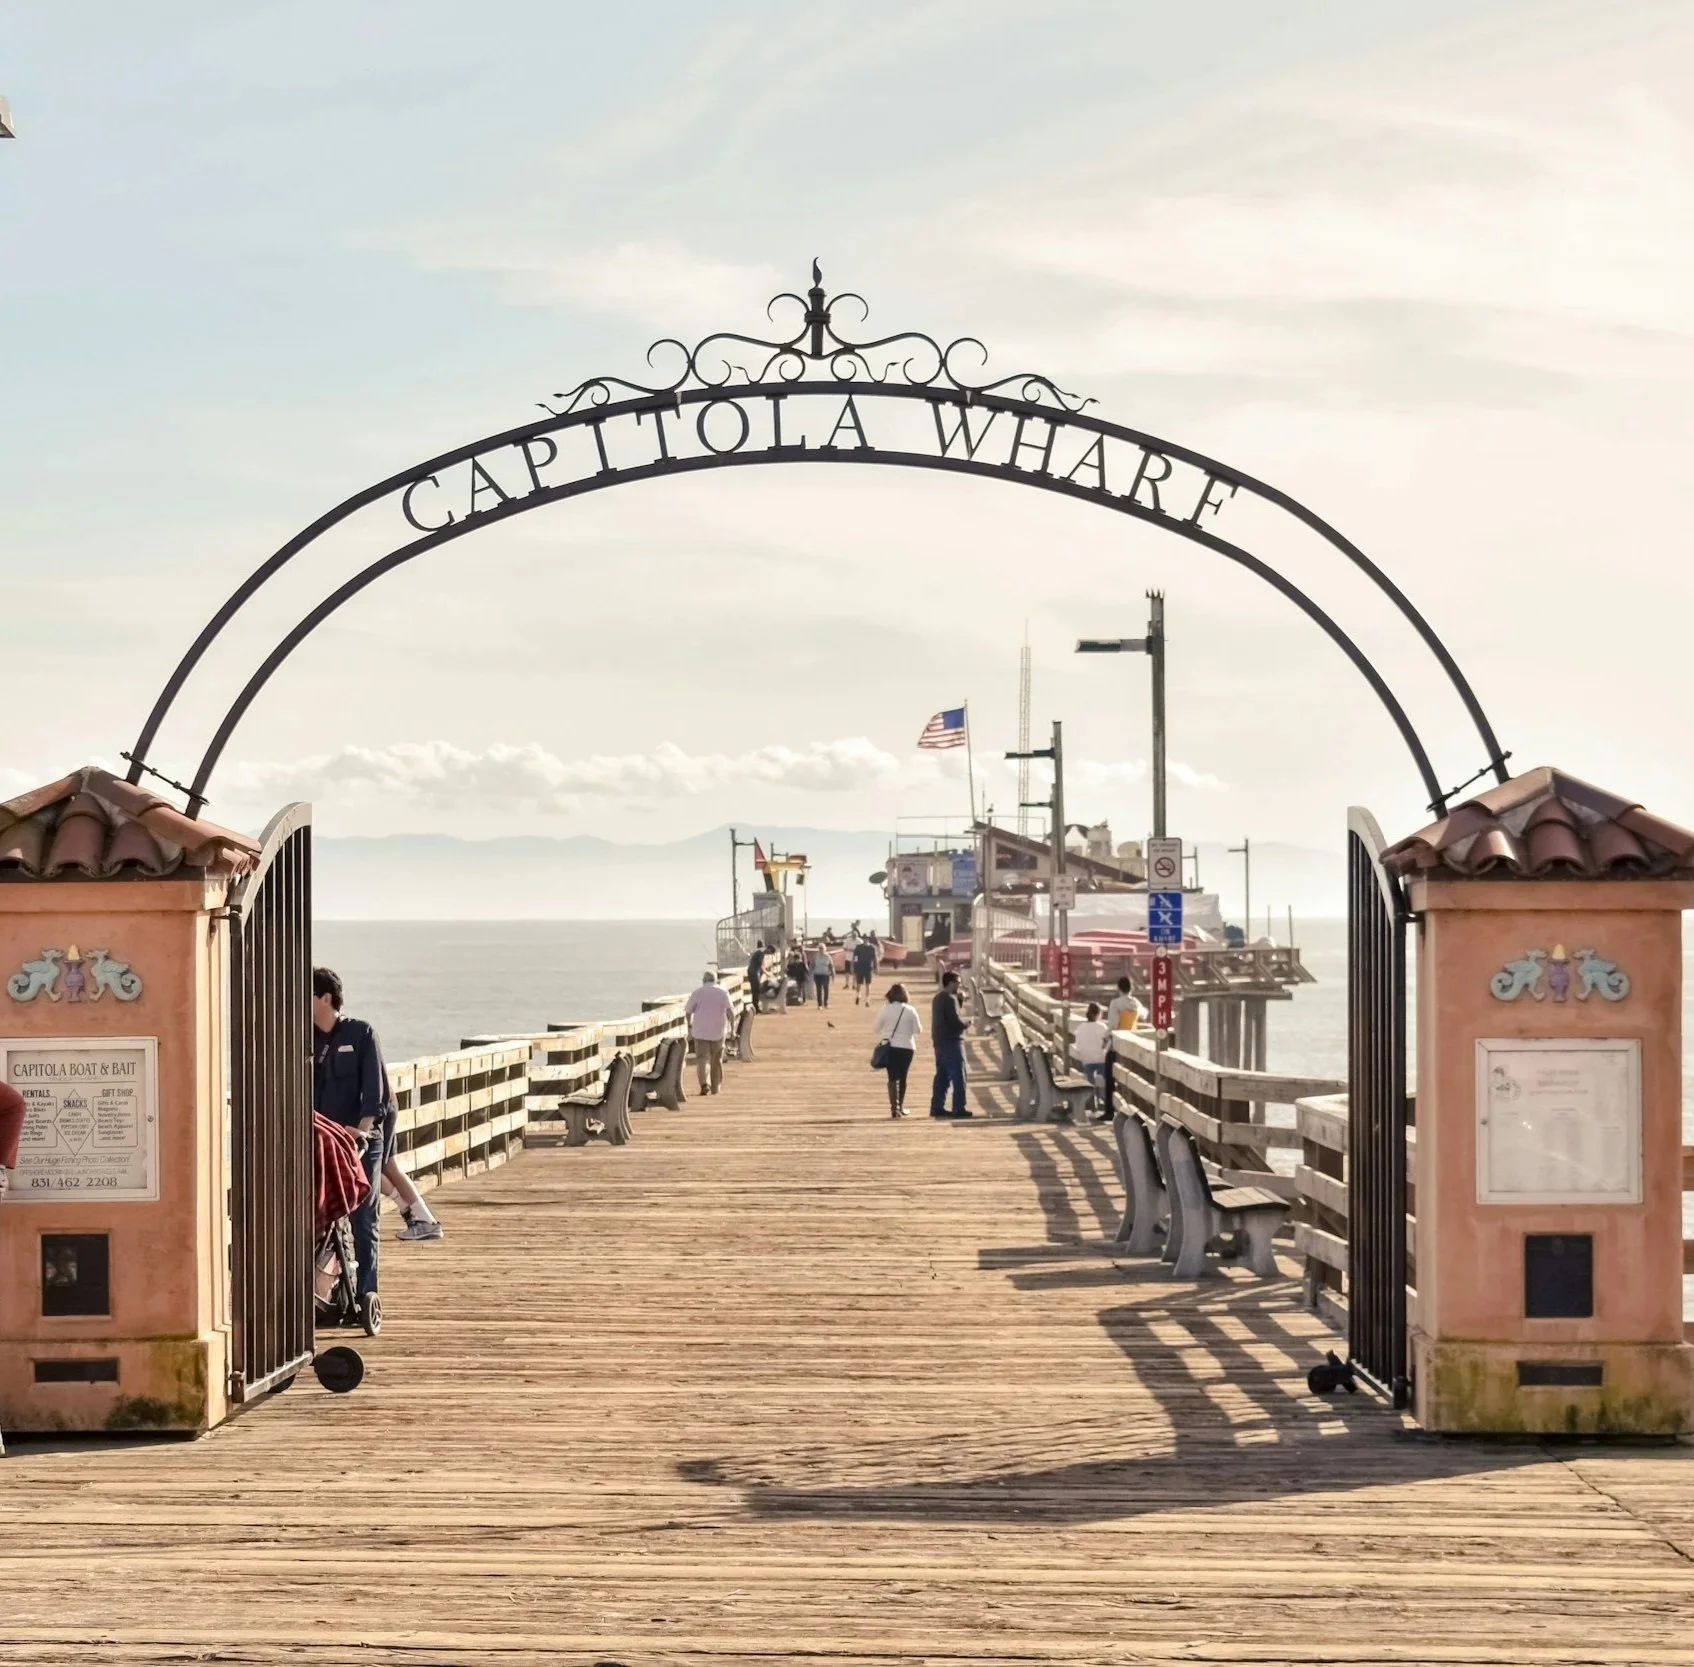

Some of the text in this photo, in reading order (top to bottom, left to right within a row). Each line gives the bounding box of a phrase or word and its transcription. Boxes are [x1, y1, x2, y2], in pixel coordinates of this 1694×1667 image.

[402, 394, 1240, 532] CAPITOLA WHARF
[13, 1061, 137, 1077] CAPITOLA BOAT & BAIT
[22, 1089, 50, 1098] RENTALS
[102, 1088, 133, 1097] GIFT SHOP
[63, 1099, 87, 1108] SNACKS
